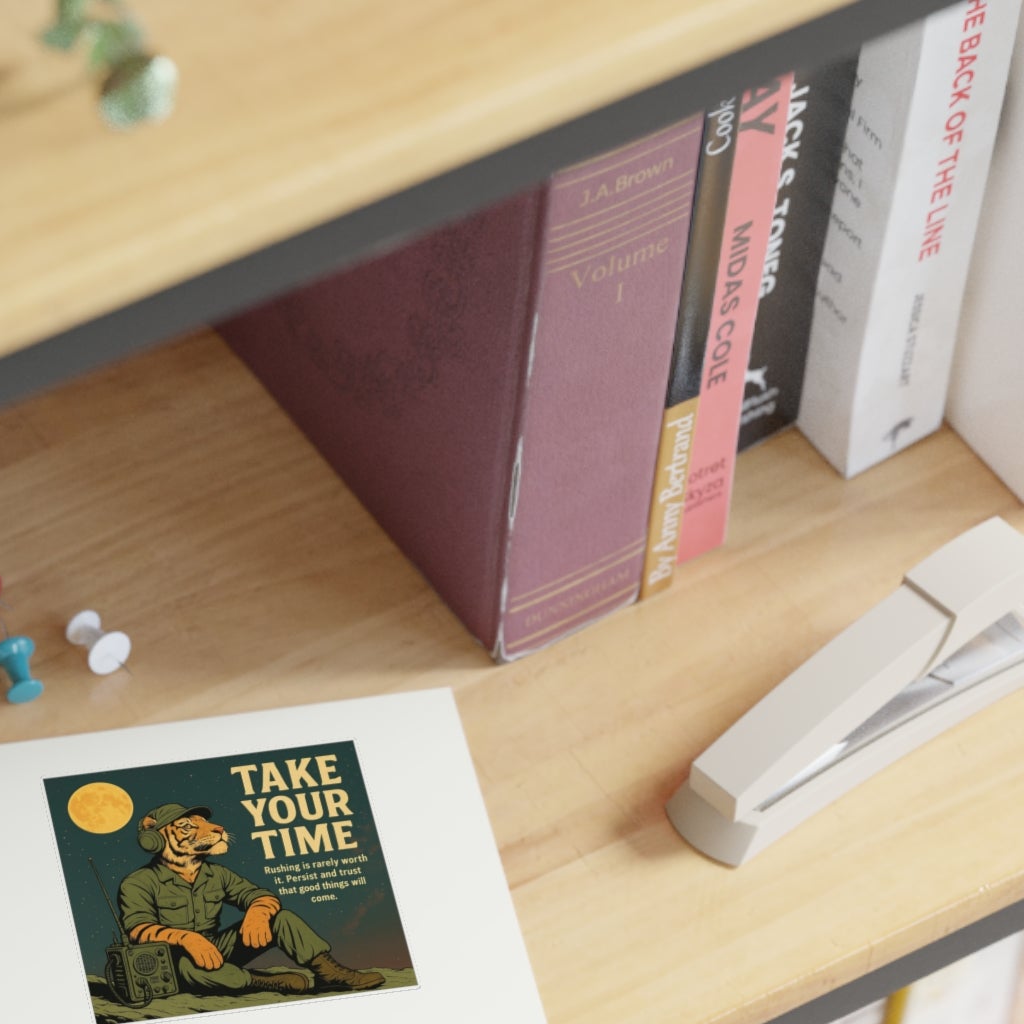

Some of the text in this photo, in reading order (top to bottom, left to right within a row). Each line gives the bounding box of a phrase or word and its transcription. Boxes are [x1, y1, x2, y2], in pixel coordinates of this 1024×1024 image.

[949, 32, 982, 108] BACK
[943, 110, 966, 146] OF
[929, 148, 960, 205] THE
[917, 203, 949, 263] LINE
[570, 237, 670, 289] Volume
[706, 220, 754, 391] MIDAS COLE
[659, 412, 694, 504] Bertrand
[648, 554, 677, 586] By
[230, 754, 342, 795] TAKE
[240, 789, 354, 827] YOUR
[251, 820, 358, 859] TIME
[264, 854, 368, 874] Rushing is rarely worth
[274, 867, 362, 884] it. Persist and trust
[279, 877, 366, 895] that good things will
[311, 894, 338, 903] come.
